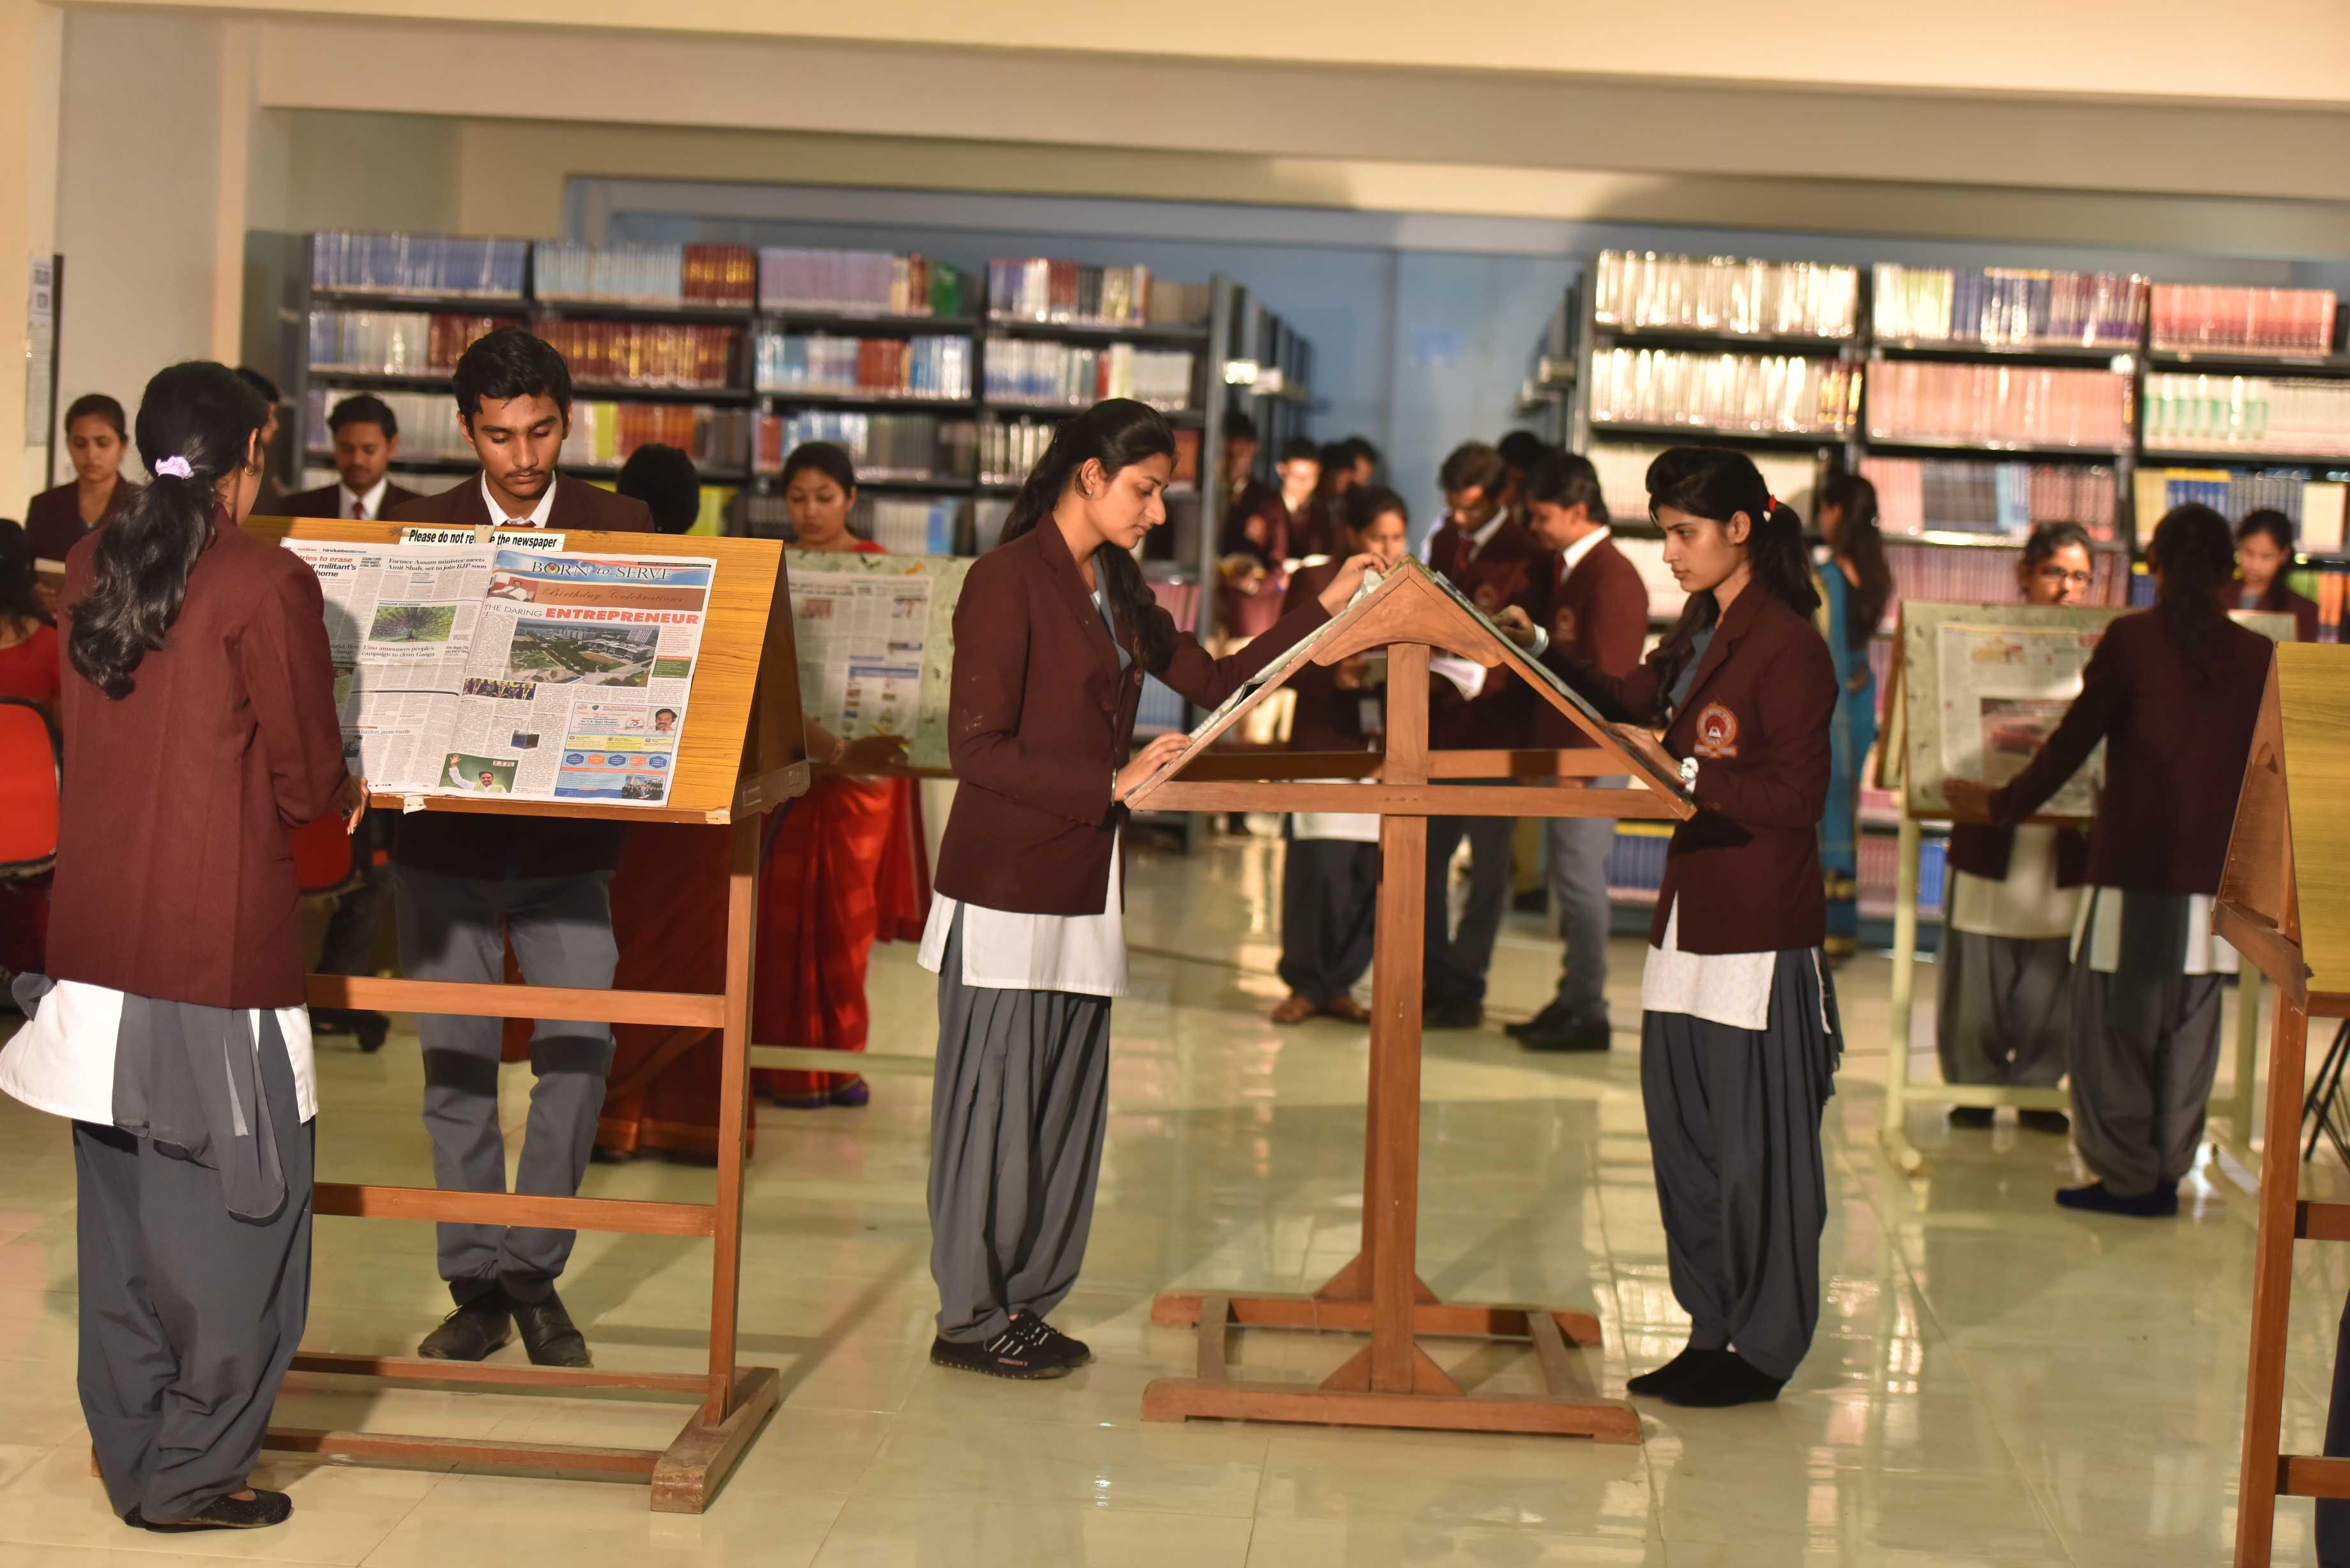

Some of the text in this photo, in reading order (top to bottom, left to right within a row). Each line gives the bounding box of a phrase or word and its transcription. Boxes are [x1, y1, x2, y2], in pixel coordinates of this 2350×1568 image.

[409, 530, 557, 550] Please do not ree the newspaper
[531, 562, 671, 580] BORN to SERVE
[543, 588, 684, 603] Birthday Celebrations
[485, 603, 699, 624] THE DARING ENTREPRENEUR
